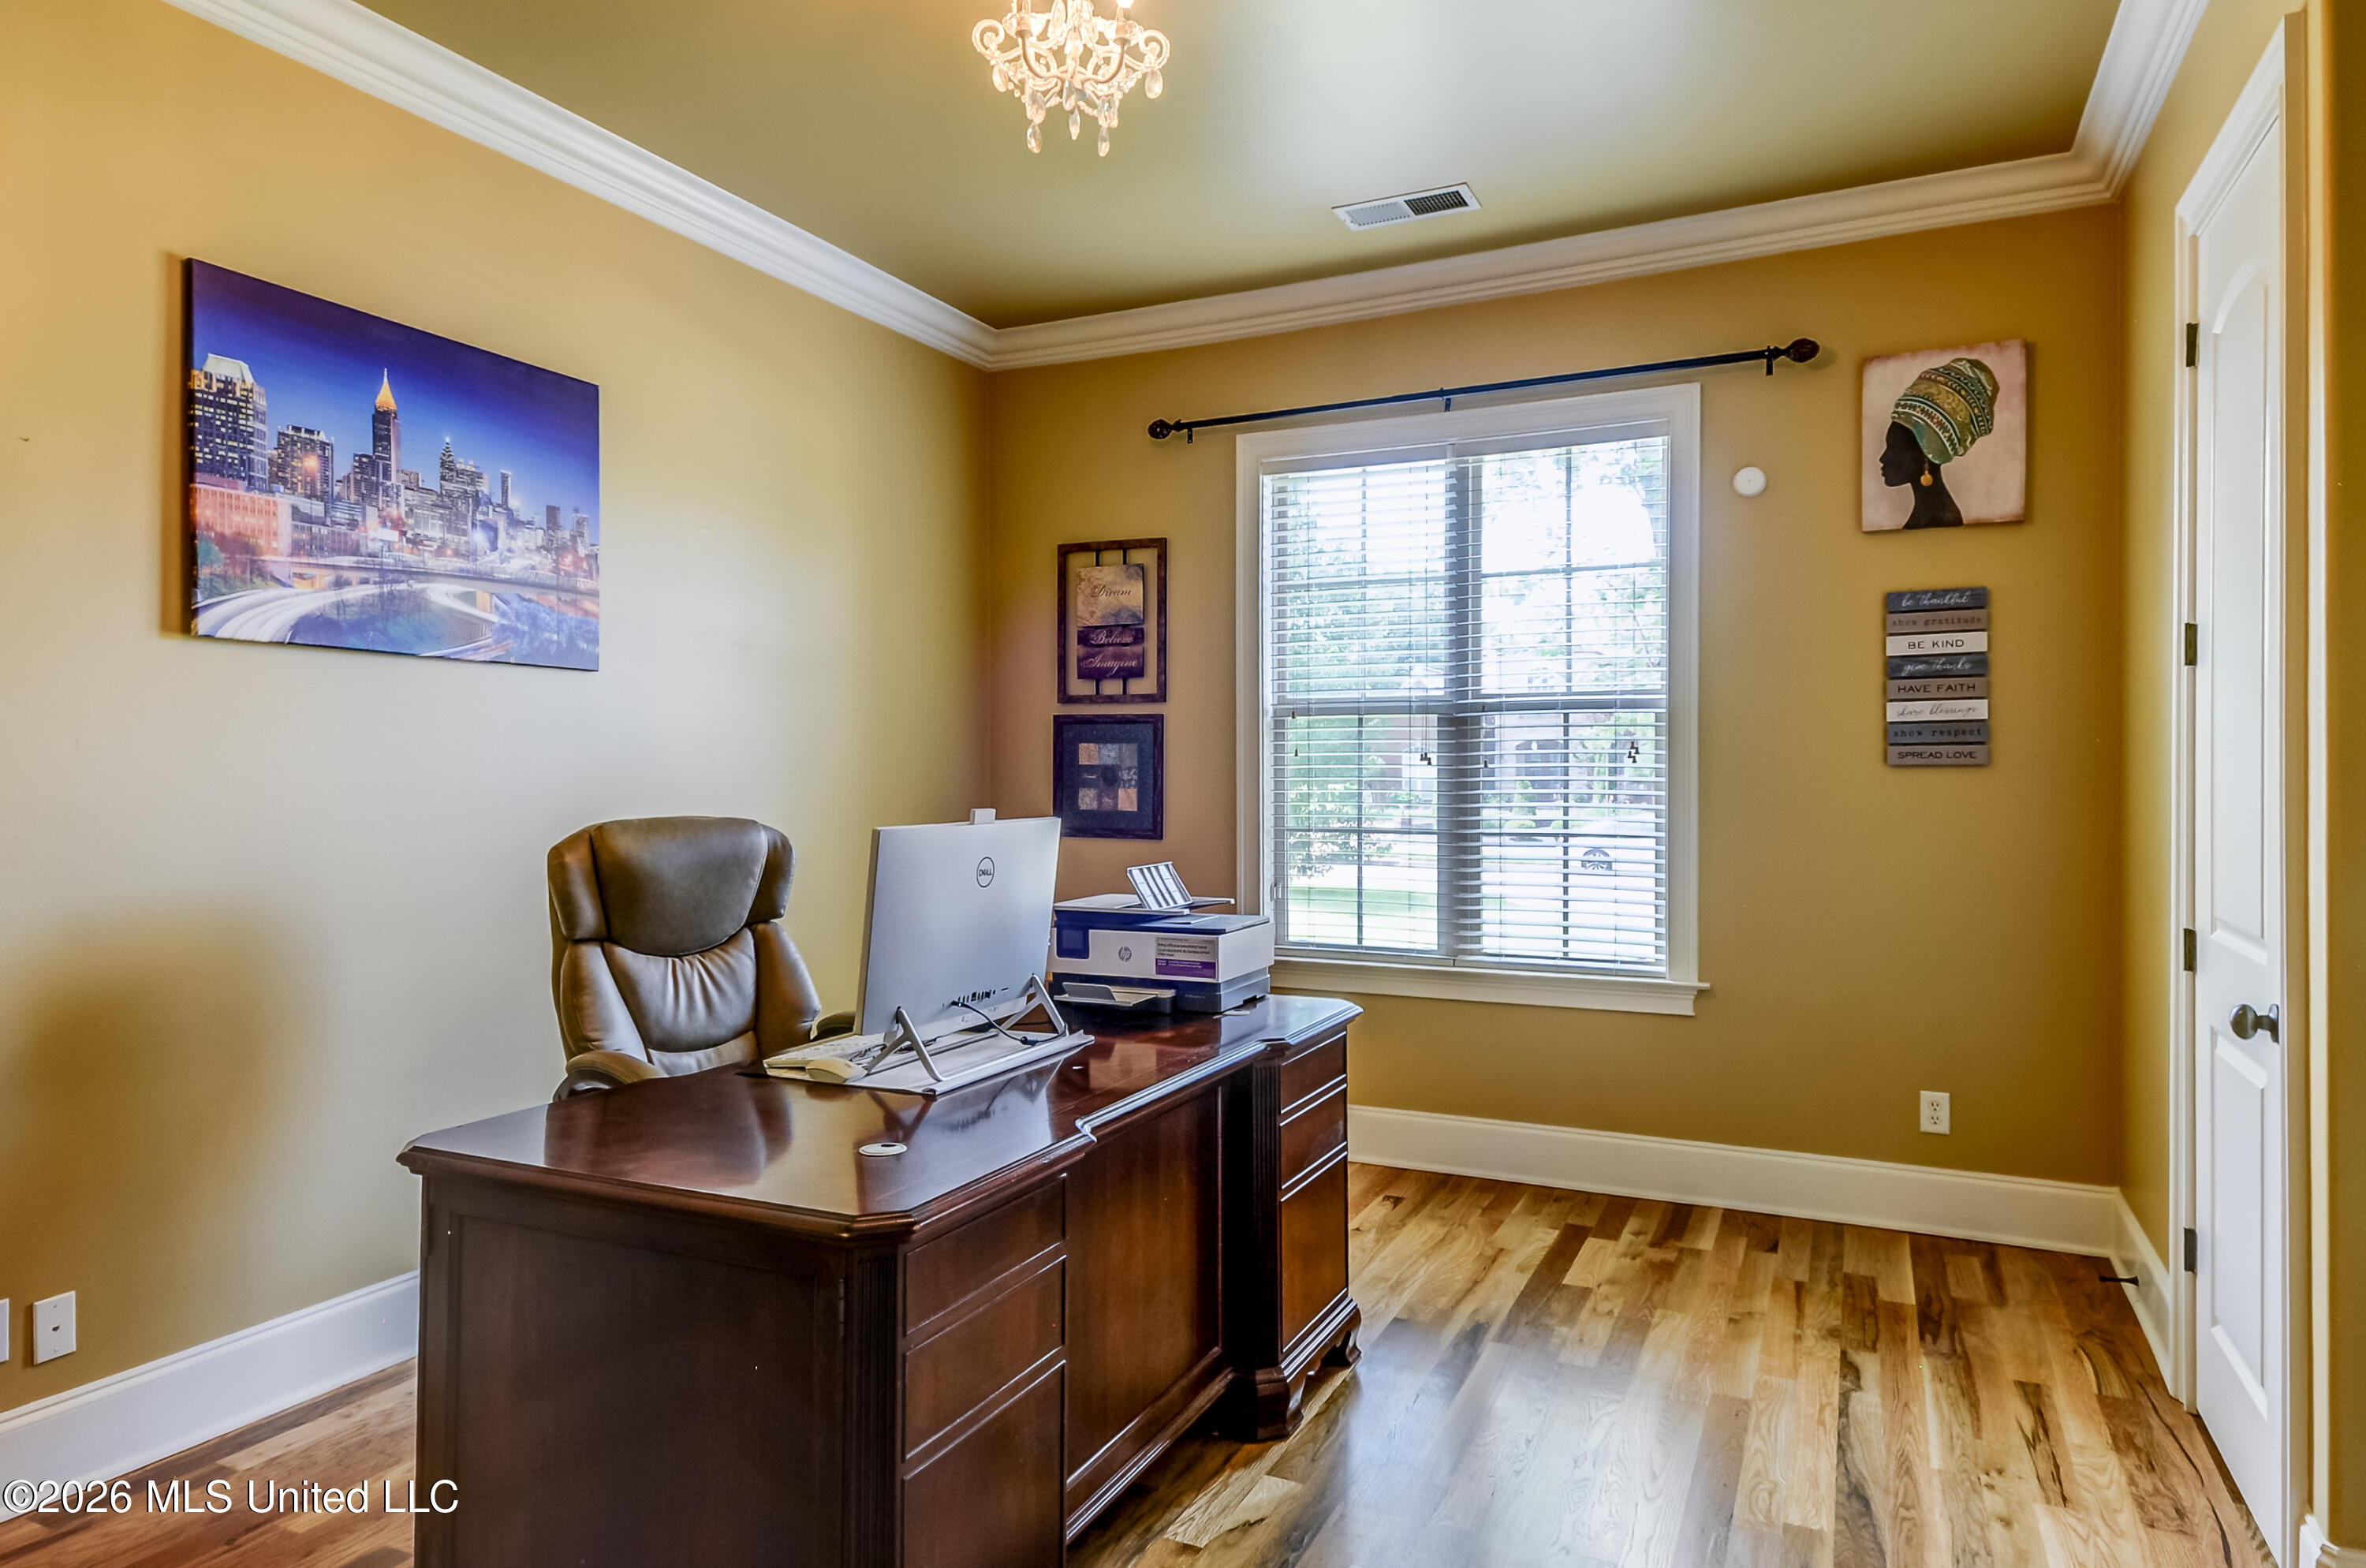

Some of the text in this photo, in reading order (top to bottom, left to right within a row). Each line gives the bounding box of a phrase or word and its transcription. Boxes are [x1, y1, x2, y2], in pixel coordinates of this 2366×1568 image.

[1092, 584, 1132, 598] Dream
[1924, 616, 1982, 626] gratitude
[1089, 629, 1133, 644] Believe
[1908, 639, 1965, 650] BE KIND
[1080, 654, 1138, 677] Imagine
[1898, 683, 1976, 693] HAVE FAITH
[1931, 729, 1982, 737] respect
[1898, 750, 1977, 760] SPREAD LOVE
[979, 868, 992, 877] DELL
[1118, 946, 1133, 962] hp
